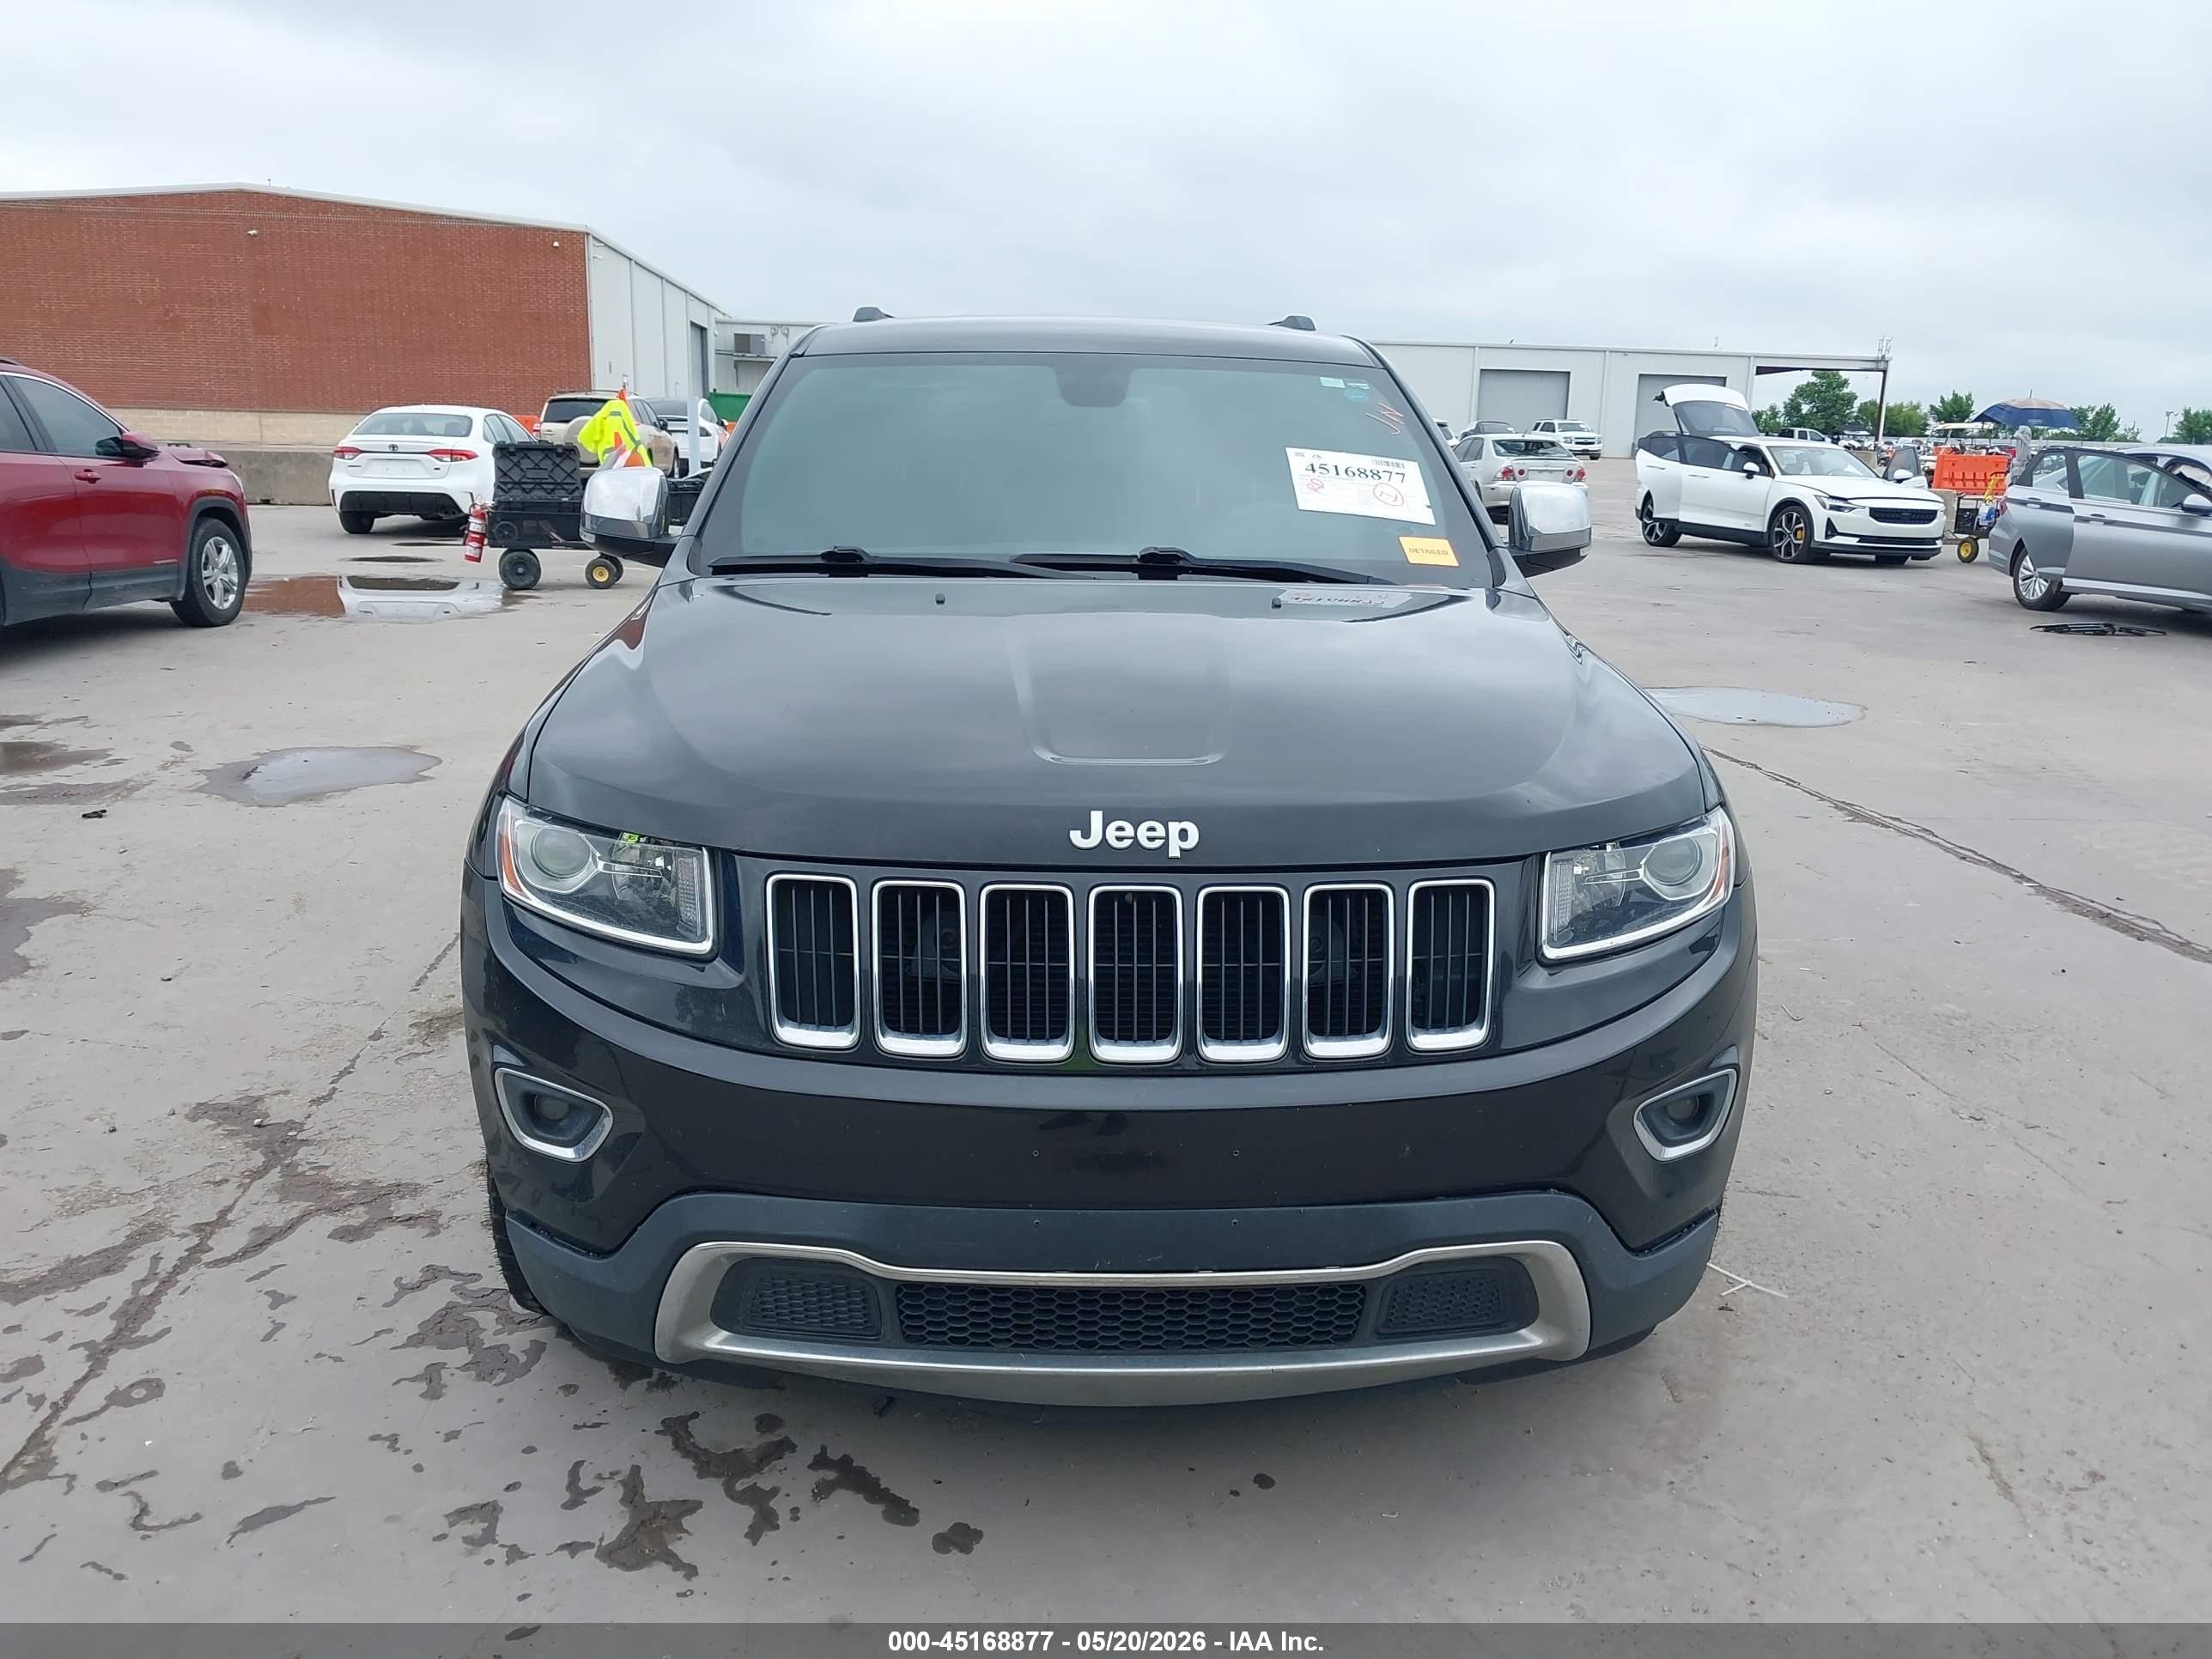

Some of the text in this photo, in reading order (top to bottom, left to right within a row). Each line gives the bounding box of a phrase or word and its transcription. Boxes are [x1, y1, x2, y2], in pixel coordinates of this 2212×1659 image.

[1304, 462, 1407, 484] 45168877
[1408, 547, 1449, 556] DETAILED
[1069, 810, 1200, 859] Jeep
